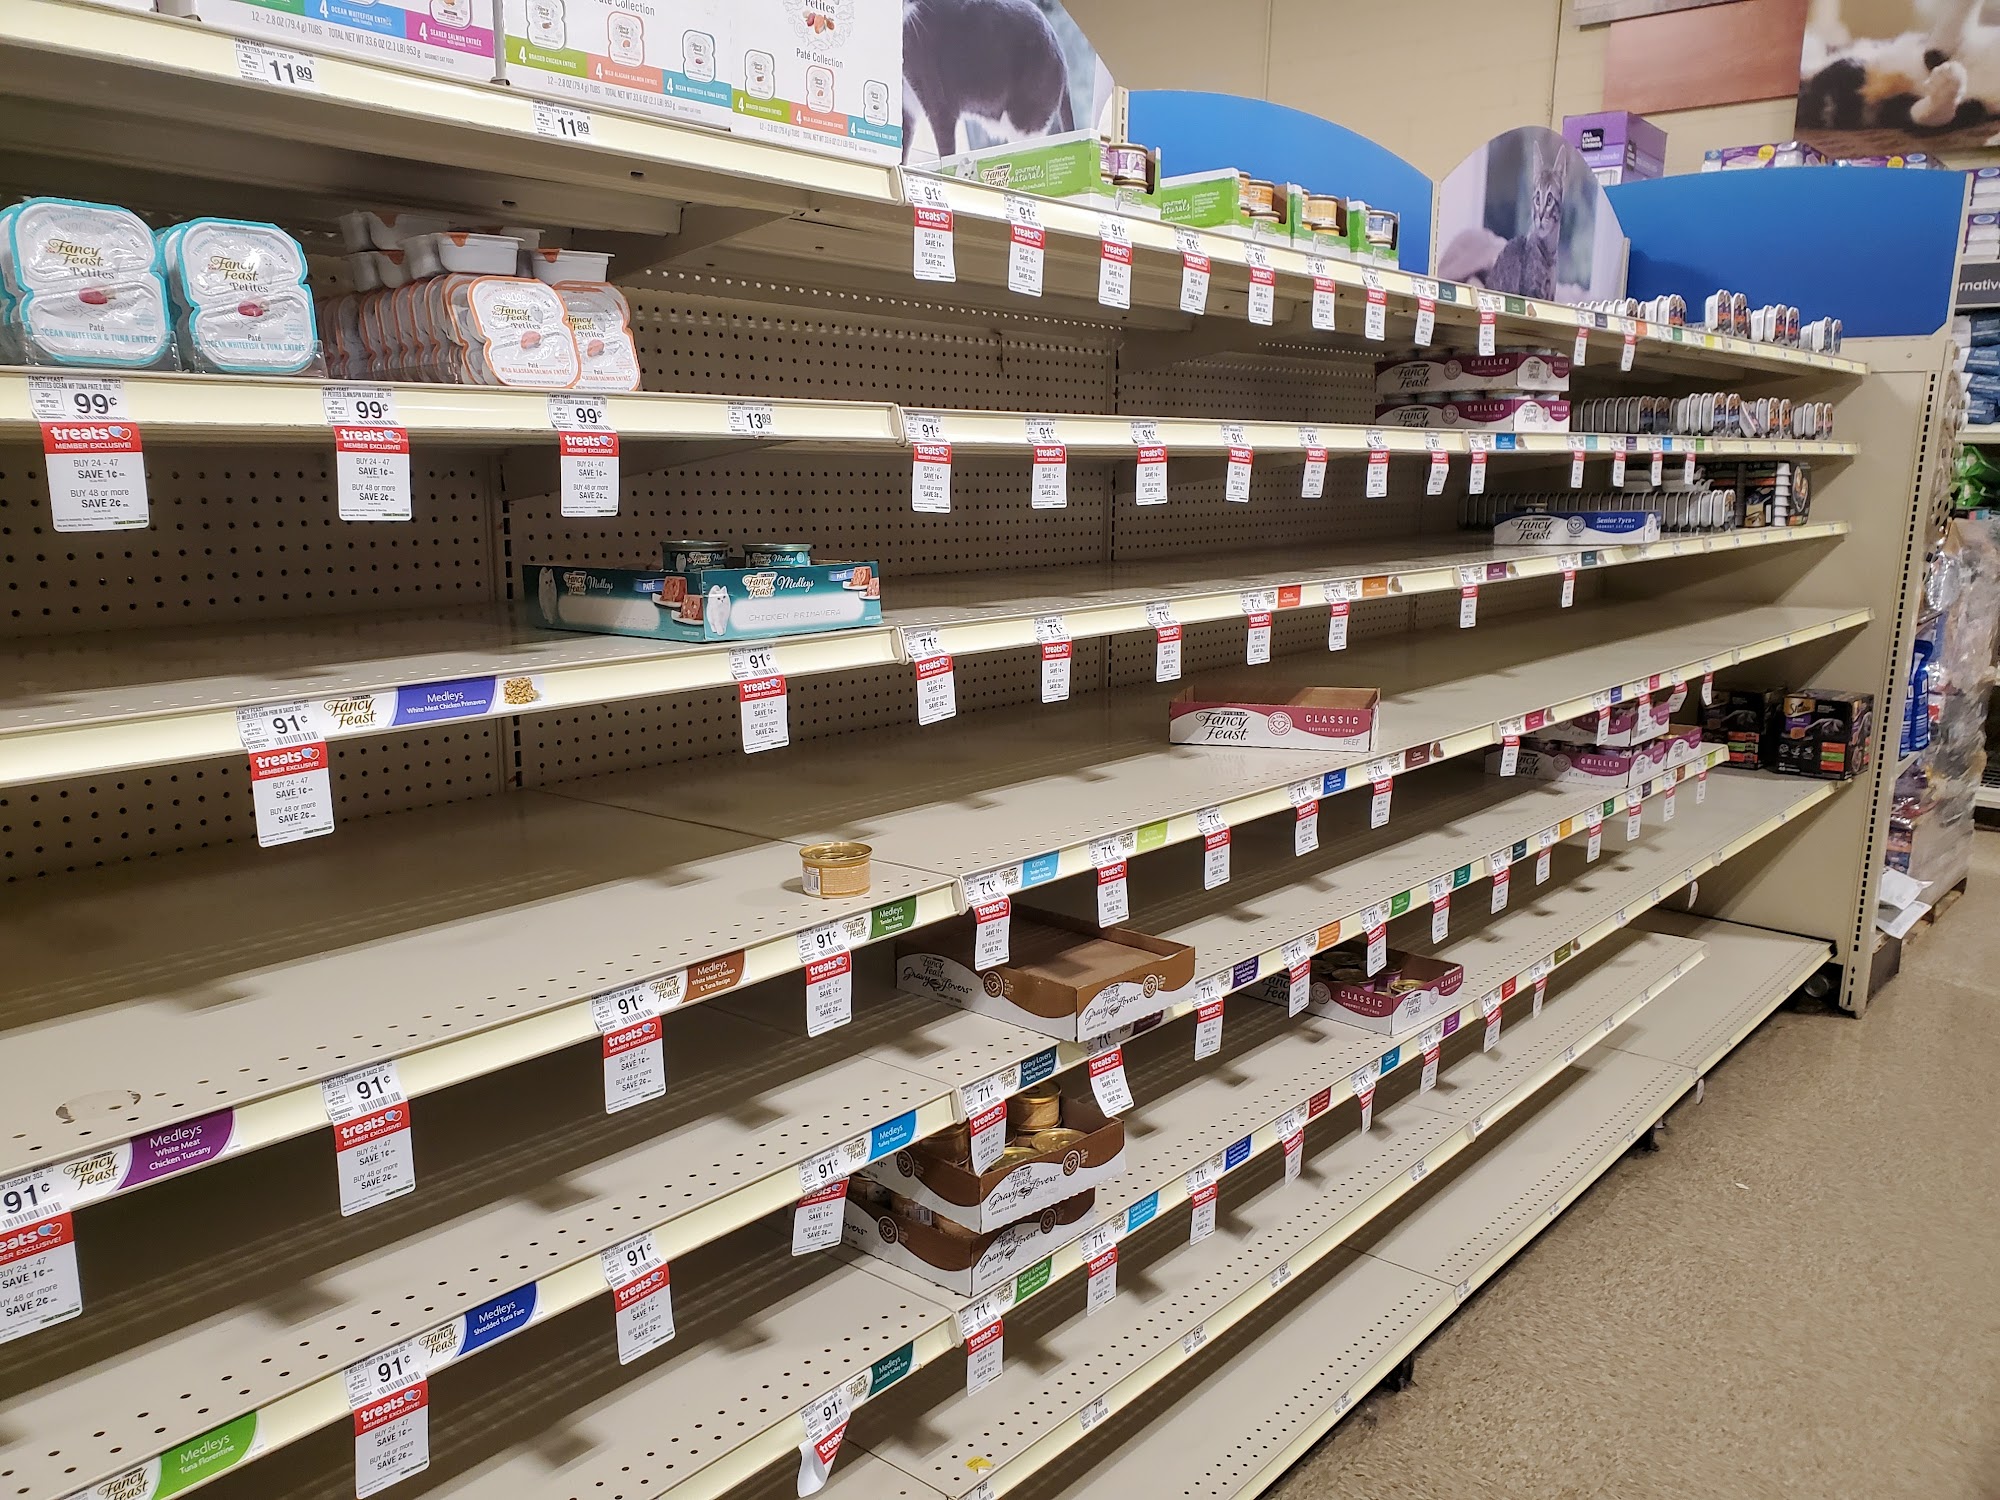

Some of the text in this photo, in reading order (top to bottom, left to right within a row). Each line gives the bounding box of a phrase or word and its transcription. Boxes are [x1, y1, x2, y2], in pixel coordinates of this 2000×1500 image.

[320, 2, 329, 19] 4
[796, 47, 843, 69] Paté Collection
[667, 77, 673, 94] 4
[738, 97, 744, 112] 4
[918, 210, 941, 221] treats
[1014, 227, 1034, 240] treats
[47, 238, 102, 261] Fancy
[1104, 244, 1122, 256] treats
[62, 254, 104, 266] Feast
[210, 255, 255, 273] Fancy
[70, 267, 115, 280] Petites
[224, 270, 258, 281] Feast
[492, 304, 528, 319] Fancy
[505, 313, 532, 322] Feast
[1400, 376, 1429, 389] Feast
[74, 393, 117, 414] 99¢
[356, 401, 388, 418] 99¢
[576, 408, 602, 423] 99¢
[1395, 408, 1429, 422] Fancy
[50, 426, 109, 440] treats
[340, 429, 385, 441] treats
[565, 435, 600, 446] treats
[917, 445, 940, 456] treats
[73, 459, 119, 467] BUY 24 47
[1510, 518, 1553, 530] Fancy
[1518, 529, 1551, 542] Feast
[587, 576, 614, 594] Medleys
[744, 575, 774, 590] Fancy
[777, 576, 814, 592] Medleys
[750, 586, 774, 598] Feast
[749, 609, 841, 622] CHICKEN PRIMAVERA
[750, 653, 771, 669] 91¢
[919, 660, 941, 672] treats
[742, 680, 771, 692] treats
[427, 691, 464, 703] Medleys
[324, 697, 376, 716] Fancy
[406, 706, 424, 714] White
[440, 702, 461, 710] Chicken
[461, 699, 487, 708] Primavera
[272, 715, 308, 734] 91¢
[335, 711, 377, 729] Feast
[1196, 711, 1250, 729] Fancy
[1305, 714, 1359, 724] CLASSIC
[1204, 725, 1249, 741] Feast
[1343, 738, 1360, 746] BEEF
[256, 751, 302, 768] treats
[1580, 757, 1620, 768] GRILLED
[259, 761, 318, 776] MEMBER EXCLUSIVE!
[272, 781, 286, 790] BUY
[276, 787, 307, 799] SAVE 1¢
[278, 812, 310, 824] SAVE 2¢
[1100, 866, 1118, 878] treats
[880, 906, 903, 918] Medleys
[978, 901, 1000, 915] treats
[816, 931, 837, 948] 91¢
[698, 961, 728, 975] Medleys
[810, 961, 837, 976] treats
[904, 967, 930, 986] Gravy
[1441, 972, 1462, 988] CLASSIC
[649, 977, 679, 994] Fancy
[653, 987, 681, 1002] Feast
[1340, 990, 1384, 1008] CLASSIC
[618, 994, 644, 1015] 91¢
[607, 1026, 643, 1047] treats
[621, 1061, 637, 1071] SAVE
[357, 1075, 391, 1100] 91¢
[341, 1115, 386, 1138] treats
[973, 1110, 995, 1129] treats
[150, 1124, 202, 1149] Medleys
[344, 1122, 402, 1147] MEMBER EXCLUSIVE!
[879, 1125, 903, 1140] Medleys
[155, 1138, 201, 1158] White Meat
[63, 1152, 118, 1179] Fancy
[149, 1146, 212, 1171] Chicken Tuscany
[359, 1150, 390, 1165] SAVE 1¢
[353, 1174, 366, 1183] BUY
[368, 1170, 375, 1178] 48
[383, 1162, 399, 1172] more
[819, 1159, 838, 1179] 91¢
[75, 1165, 119, 1190] Feast
[361, 1173, 392, 1189] SAVE 2¢
[3, 1183, 50, 1214] 91¢
[16, 1237, 62, 1256] EXCLUSIVE!
[627, 1243, 652, 1266] 91¢
[17, 1257, 47, 1273] 24 47
[2, 1268, 45, 1289] SAVE 1¢
[14, 1283, 57, 1302] 48 or more
[619, 1276, 652, 1301] treats
[6, 1297, 49, 1317] SAVE 2¢
[478, 1301, 516, 1323] Medleys
[473, 1308, 525, 1336] Shredded Tuna Fare
[419, 1325, 456, 1349] Fancy
[970, 1330, 992, 1348] treats
[428, 1335, 458, 1358] Feast
[377, 1355, 411, 1383] 91¢
[361, 1396, 405, 1423] treats
[363, 1402, 420, 1430] MEMBER EXCLUSIVE!
[823, 1399, 843, 1420] 91¢
[180, 1434, 230, 1463] Medleys
[377, 1435, 396, 1447] SAVE
[179, 1444, 235, 1474] Tuna Florentine
[377, 1458, 395, 1470] SAVE
[97, 1469, 149, 1497] Fancy
